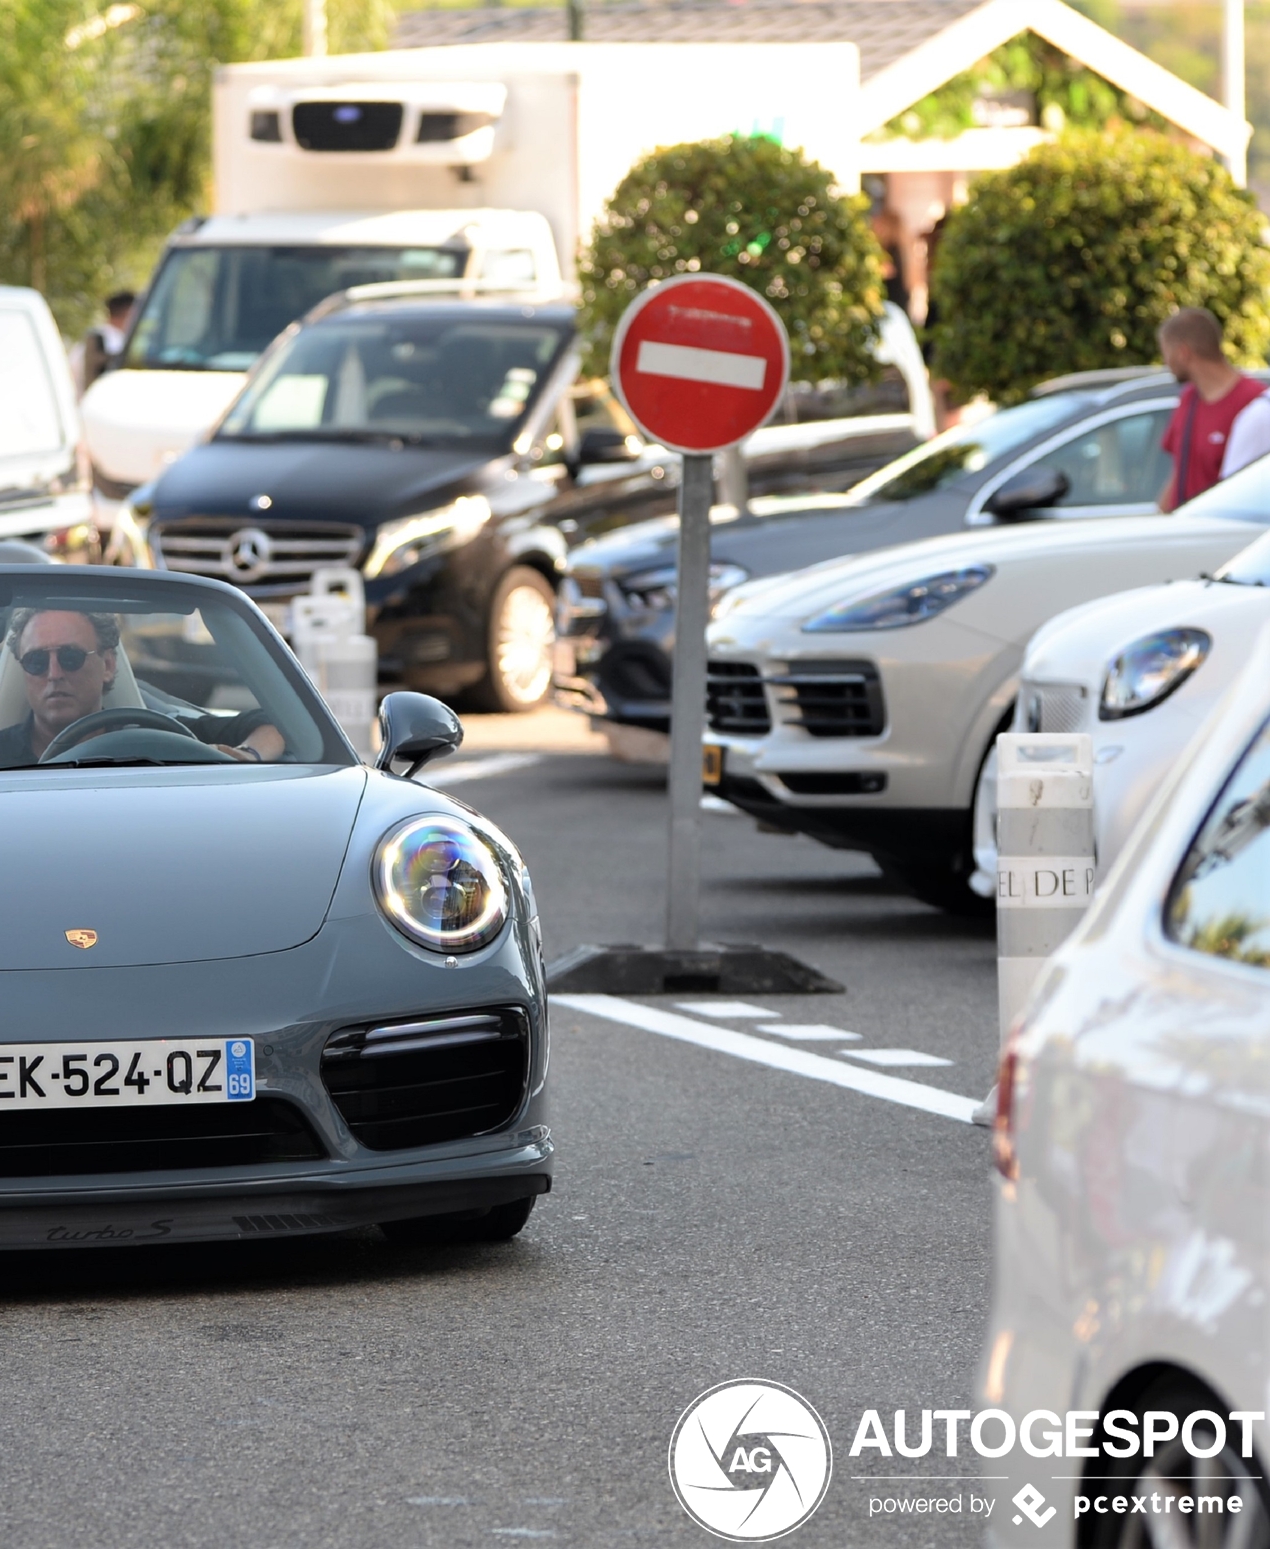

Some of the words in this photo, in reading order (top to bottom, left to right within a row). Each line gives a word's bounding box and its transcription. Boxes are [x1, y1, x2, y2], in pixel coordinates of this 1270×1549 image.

[1034, 868, 1076, 897] DE
[229, 1073, 251, 1095] 69
[46, 1224, 134, 1241] turbo
[134, 1219, 174, 1240] S
